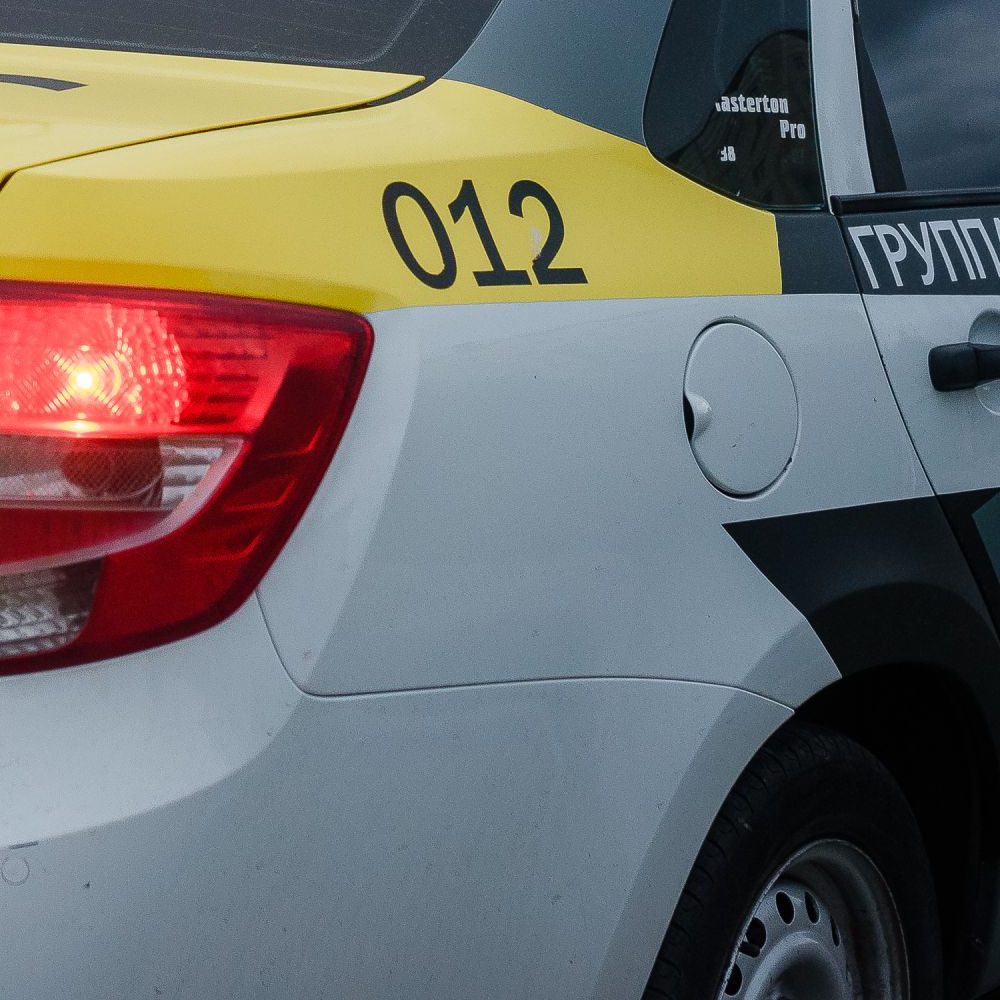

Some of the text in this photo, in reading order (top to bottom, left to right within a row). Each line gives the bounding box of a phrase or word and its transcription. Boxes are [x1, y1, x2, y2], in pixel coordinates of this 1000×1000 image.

[779, 119, 807, 139] Pro
[381, 179, 589, 290] 012
[847, 217, 1000, 289] ГРУПП
